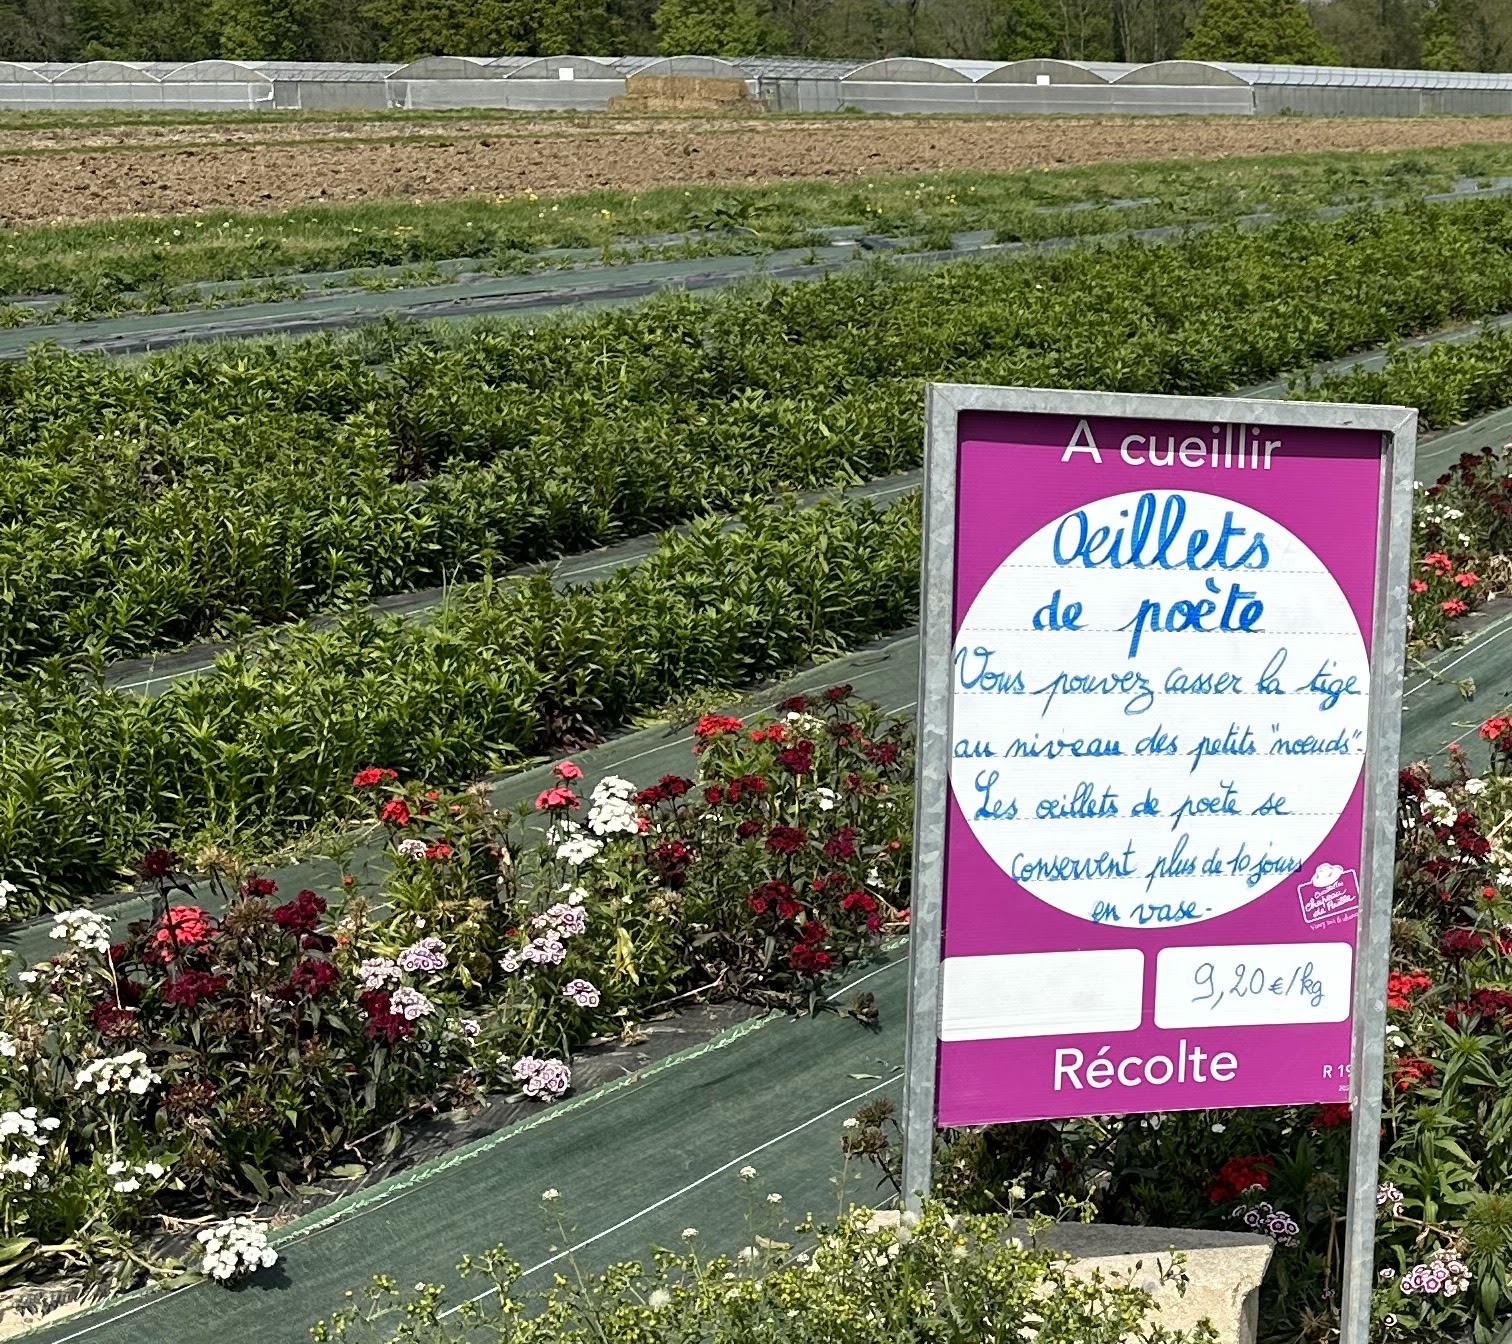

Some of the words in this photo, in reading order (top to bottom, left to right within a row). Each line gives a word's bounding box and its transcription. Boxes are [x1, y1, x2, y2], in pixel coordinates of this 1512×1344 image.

[1061, 419, 1103, 464] A
[1120, 422, 1282, 470] cueillir
[1032, 589, 1089, 631] de
[1117, 577, 1266, 660] poète
[954, 646, 1026, 694] Vous
[1033, 670, 1155, 718] pouvez
[1255, 647, 1287, 695] la
[1295, 659, 1361, 711] tige
[954, 739, 996, 758] au
[1005, 732, 1124, 760] niveau
[1135, 723, 1178, 756] des
[1187, 722, 1257, 774] petits
[974, 769, 1018, 822] Les
[1131, 787, 1162, 816] de
[1251, 792, 1292, 816] se
[1144, 833, 1198, 892] plus
[1202, 847, 1224, 875] de
[1226, 842, 1250, 872] 10
[1247, 841, 1302, 889] jours
[1089, 900, 1121, 924] en
[1053, 1038, 1239, 1092] Récolte
[1322, 1064, 1333, 1079] R
